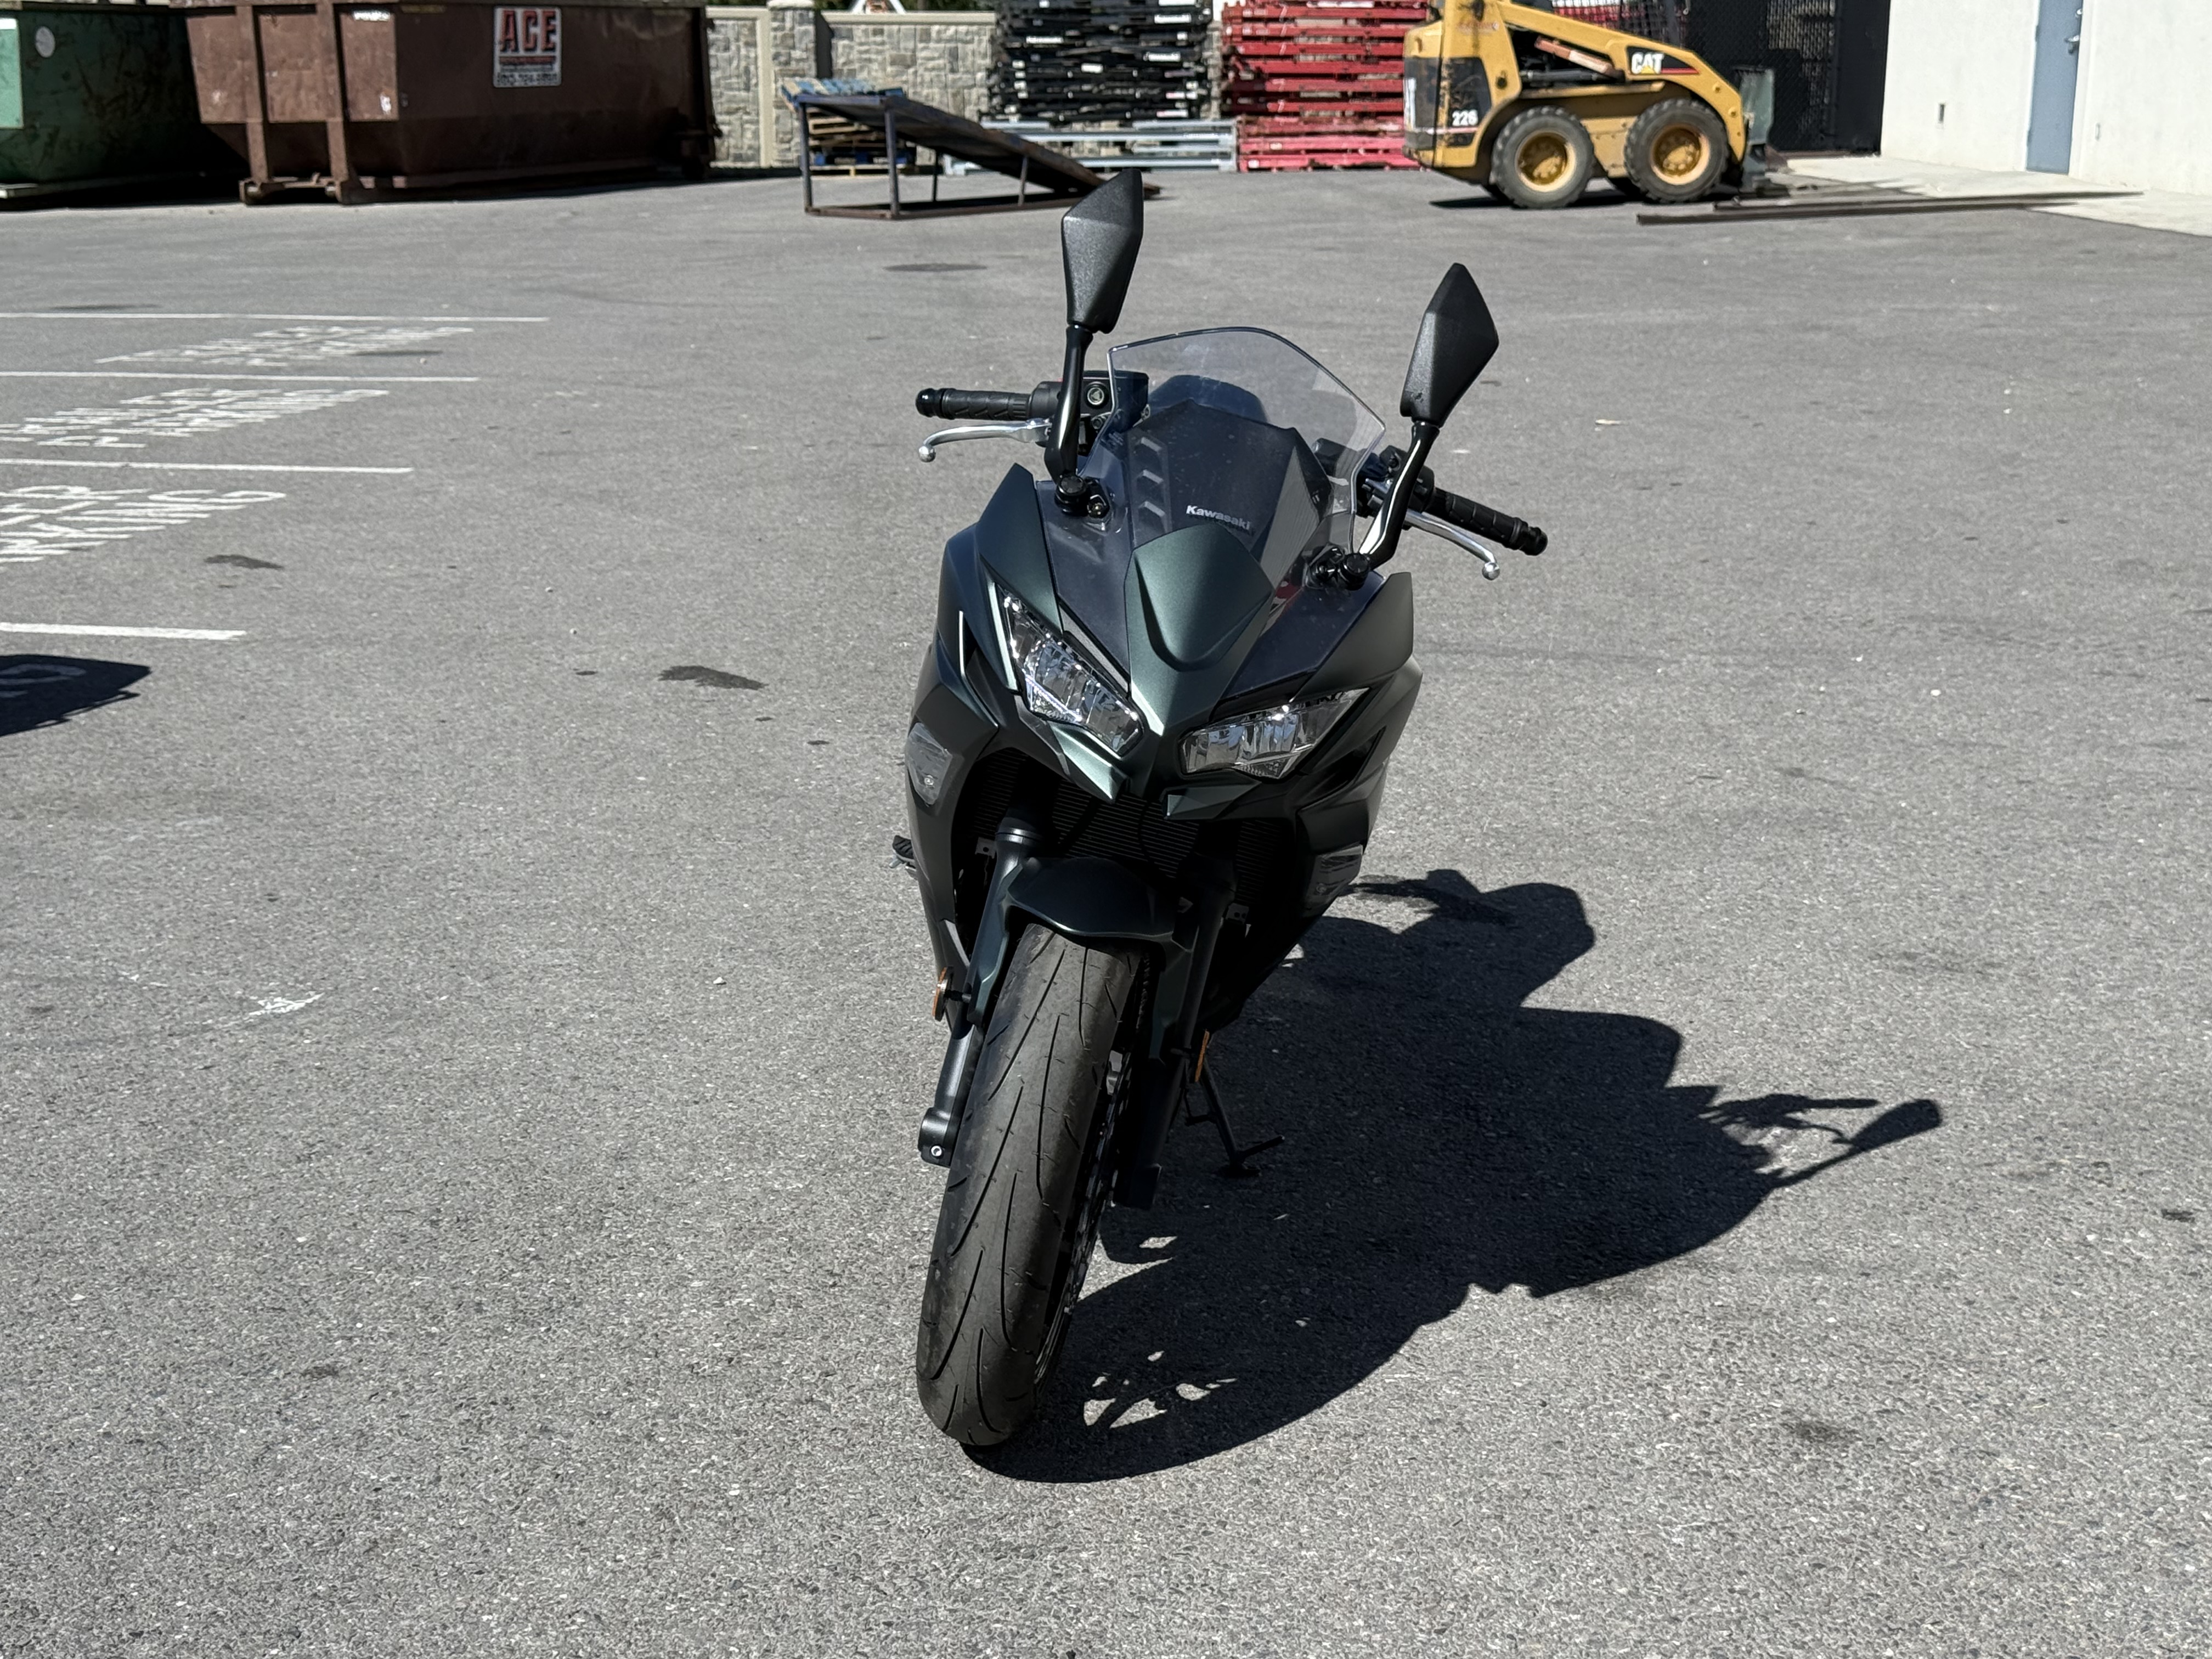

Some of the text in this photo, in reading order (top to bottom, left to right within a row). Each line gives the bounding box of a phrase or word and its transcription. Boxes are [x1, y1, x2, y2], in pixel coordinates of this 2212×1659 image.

[500, 10, 556, 52] ACE
[1632, 52, 1664, 75] CAT
[1186, 505, 1251, 531] Kawasaki
